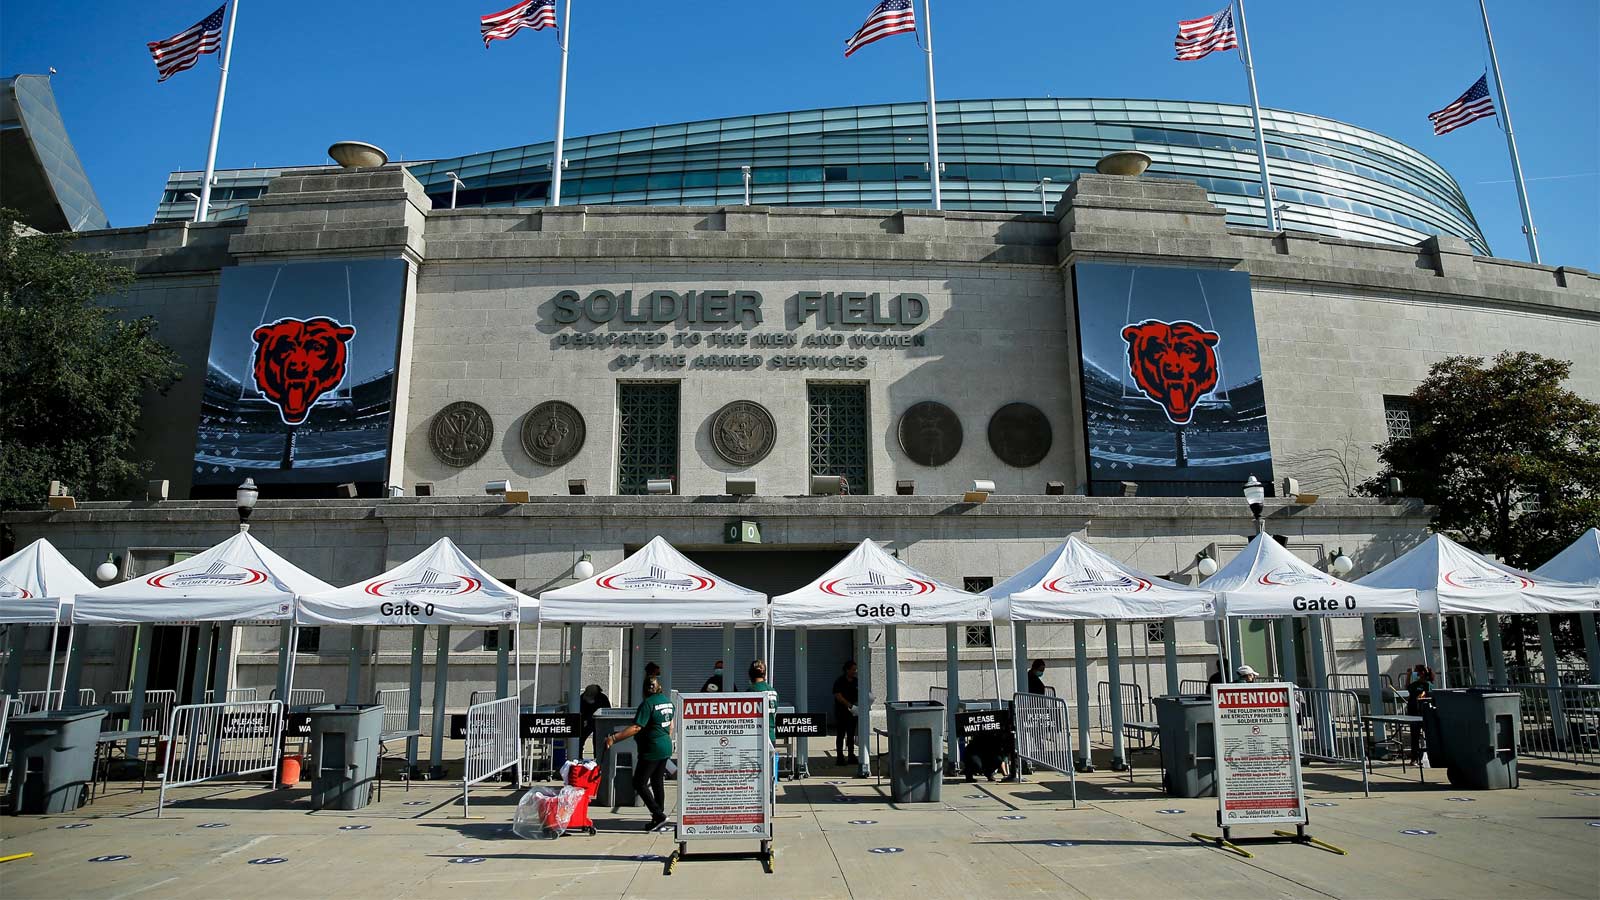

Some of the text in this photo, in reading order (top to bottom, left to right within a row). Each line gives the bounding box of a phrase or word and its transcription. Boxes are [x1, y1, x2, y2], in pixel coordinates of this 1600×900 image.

[553, 289, 930, 325] SOLDIER FIELD
[559, 333, 926, 347] DEDICATED TO THE MEN AND WOMEN
[617, 354, 868, 368] OF THE ARMED SERVICES
[731, 526, 737, 538] 0
[748, 526, 754, 538] 0
[381, 602, 434, 616] Gate 0
[1293, 595, 1356, 611] Gate 0
[856, 603, 910, 617] Gate 0
[1218, 692, 1288, 704] ATTENTION
[684, 702, 763, 715] ATTENTION
[968, 715, 994, 723] PLEASE
[982, 722, 1000, 730] HERE
